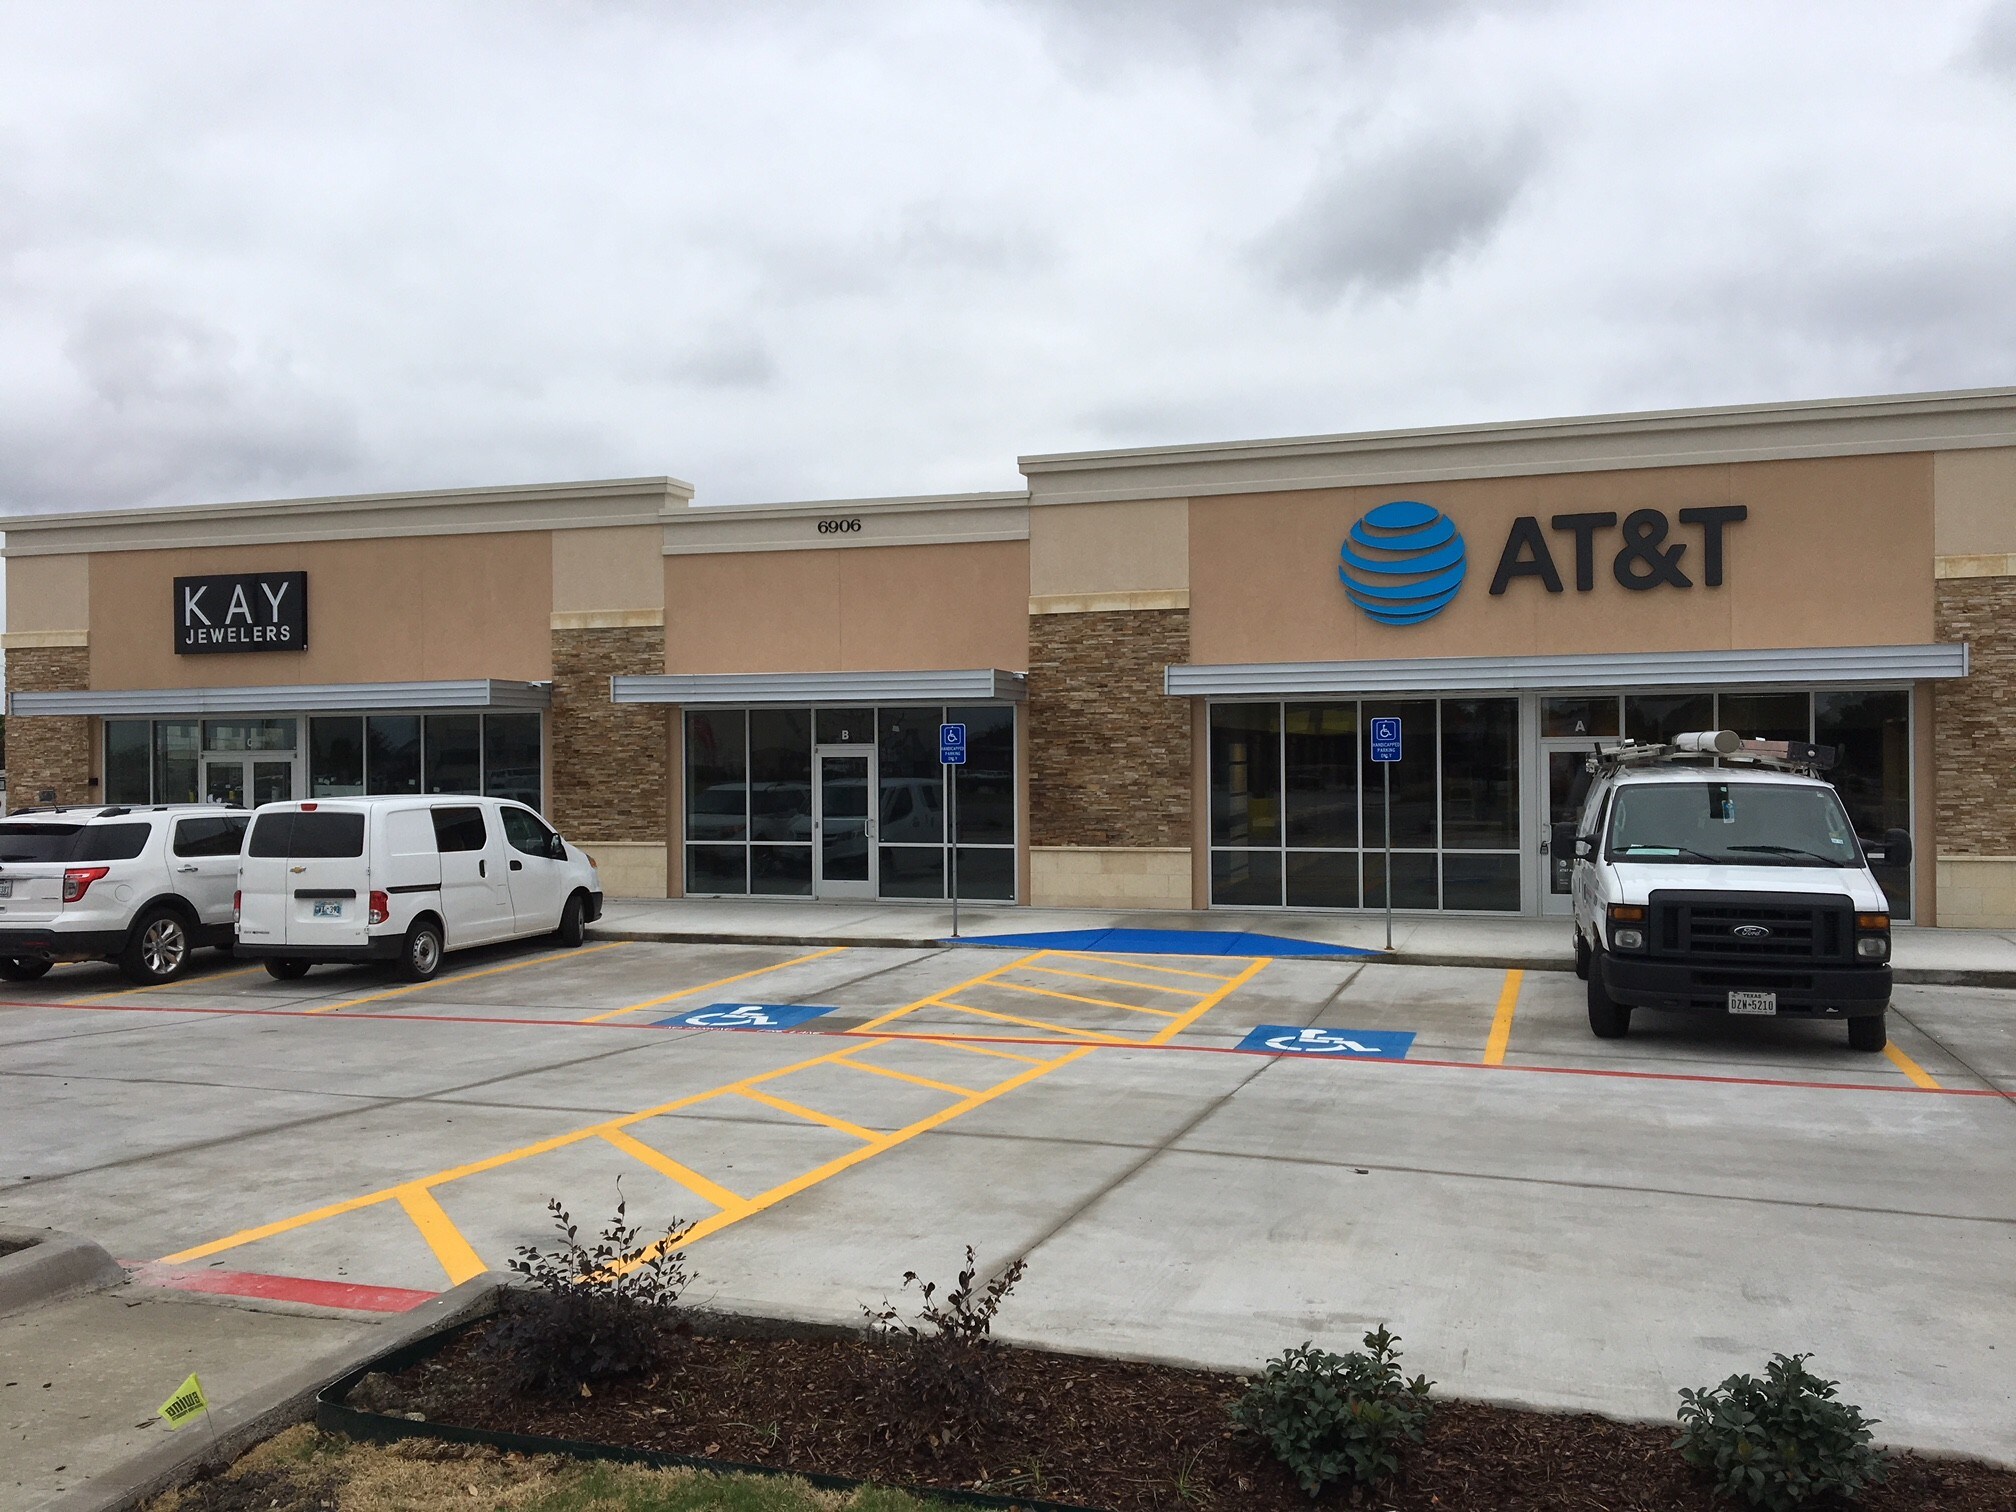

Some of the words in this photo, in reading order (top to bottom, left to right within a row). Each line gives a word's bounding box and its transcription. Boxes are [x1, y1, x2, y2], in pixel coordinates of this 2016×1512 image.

[818, 519, 861, 533] 6906
[1489, 505, 1747, 595] AT&T
[184, 581, 289, 626] KAY
[186, 625, 290, 644] JEWELERS
[1575, 720, 1585, 731] A
[842, 730, 849, 740] B
[1742, 927, 1762, 936] Ford
